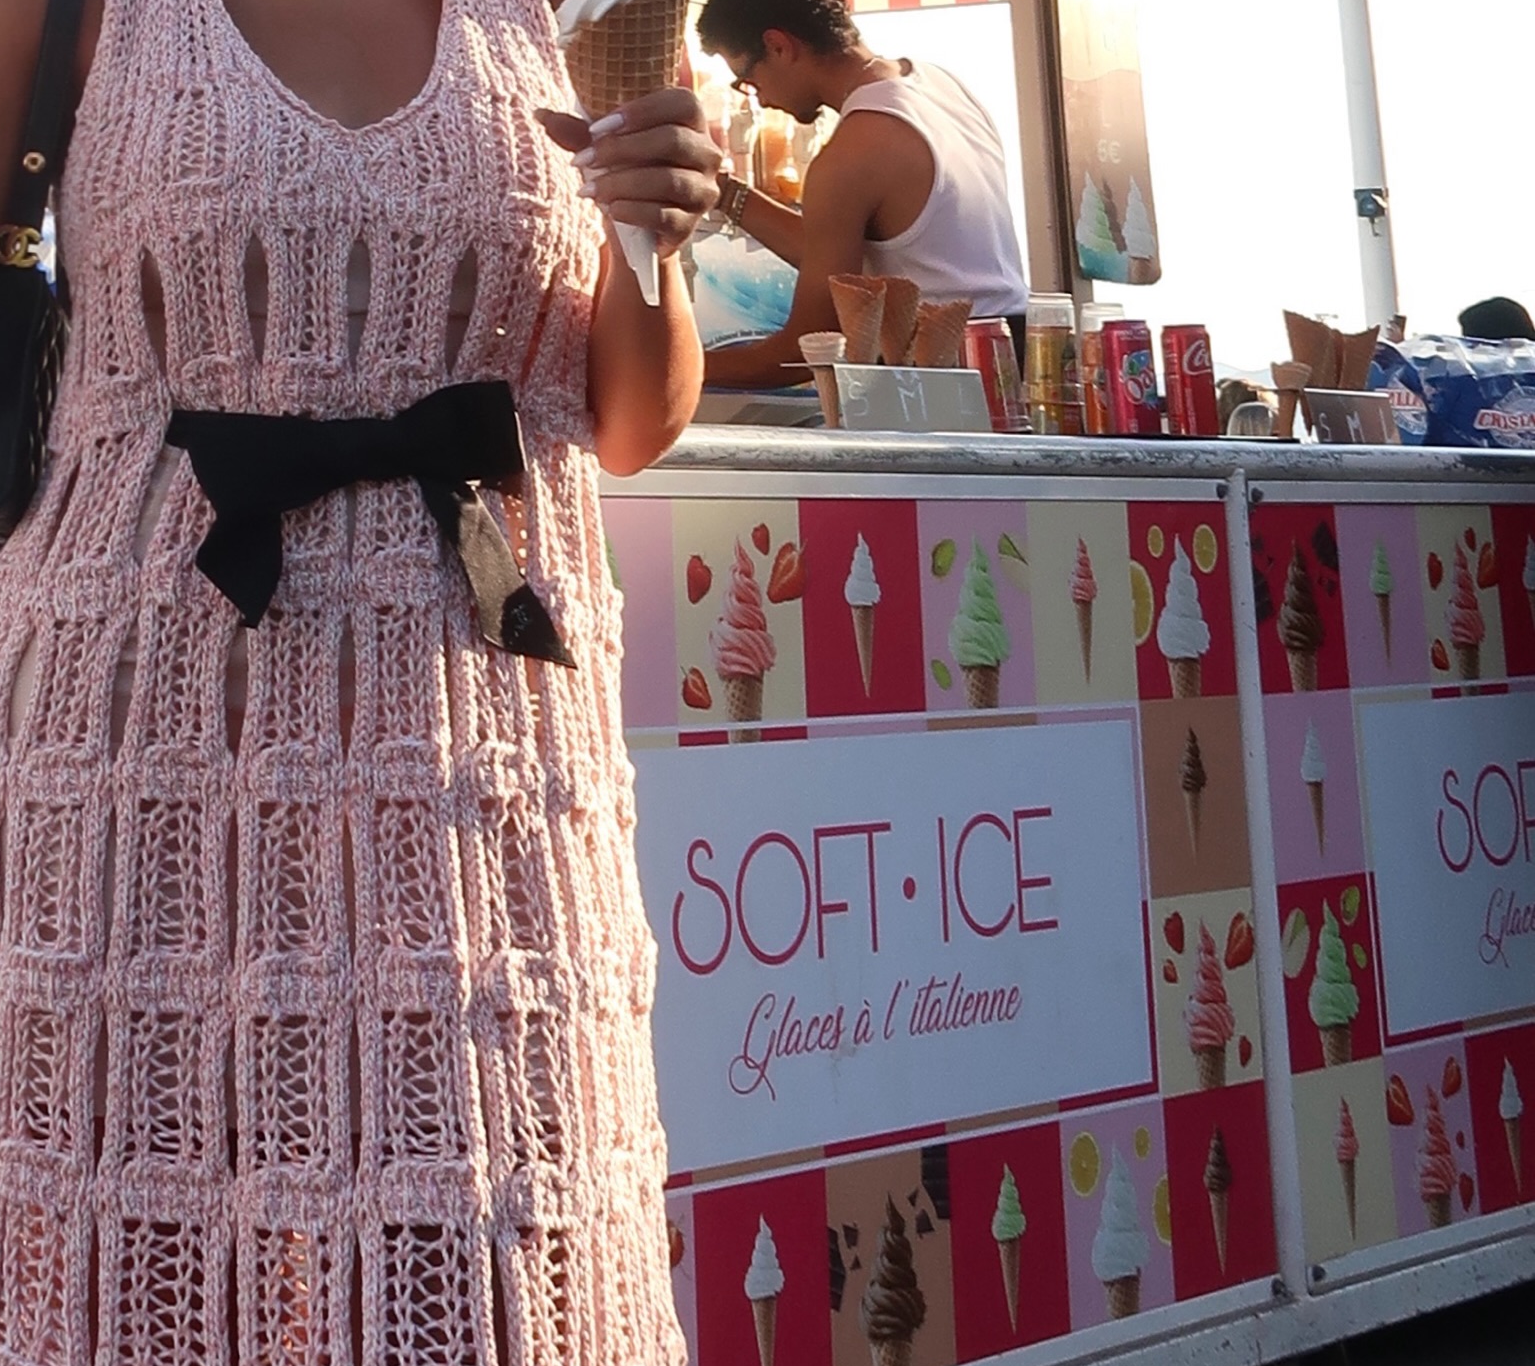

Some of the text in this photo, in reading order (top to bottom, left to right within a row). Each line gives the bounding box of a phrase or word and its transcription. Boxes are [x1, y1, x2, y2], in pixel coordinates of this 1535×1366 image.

[672, 806, 1059, 976] SOFT ICE
[728, 992, 846, 1102] Glaces
[853, 999, 874, 1046] à
